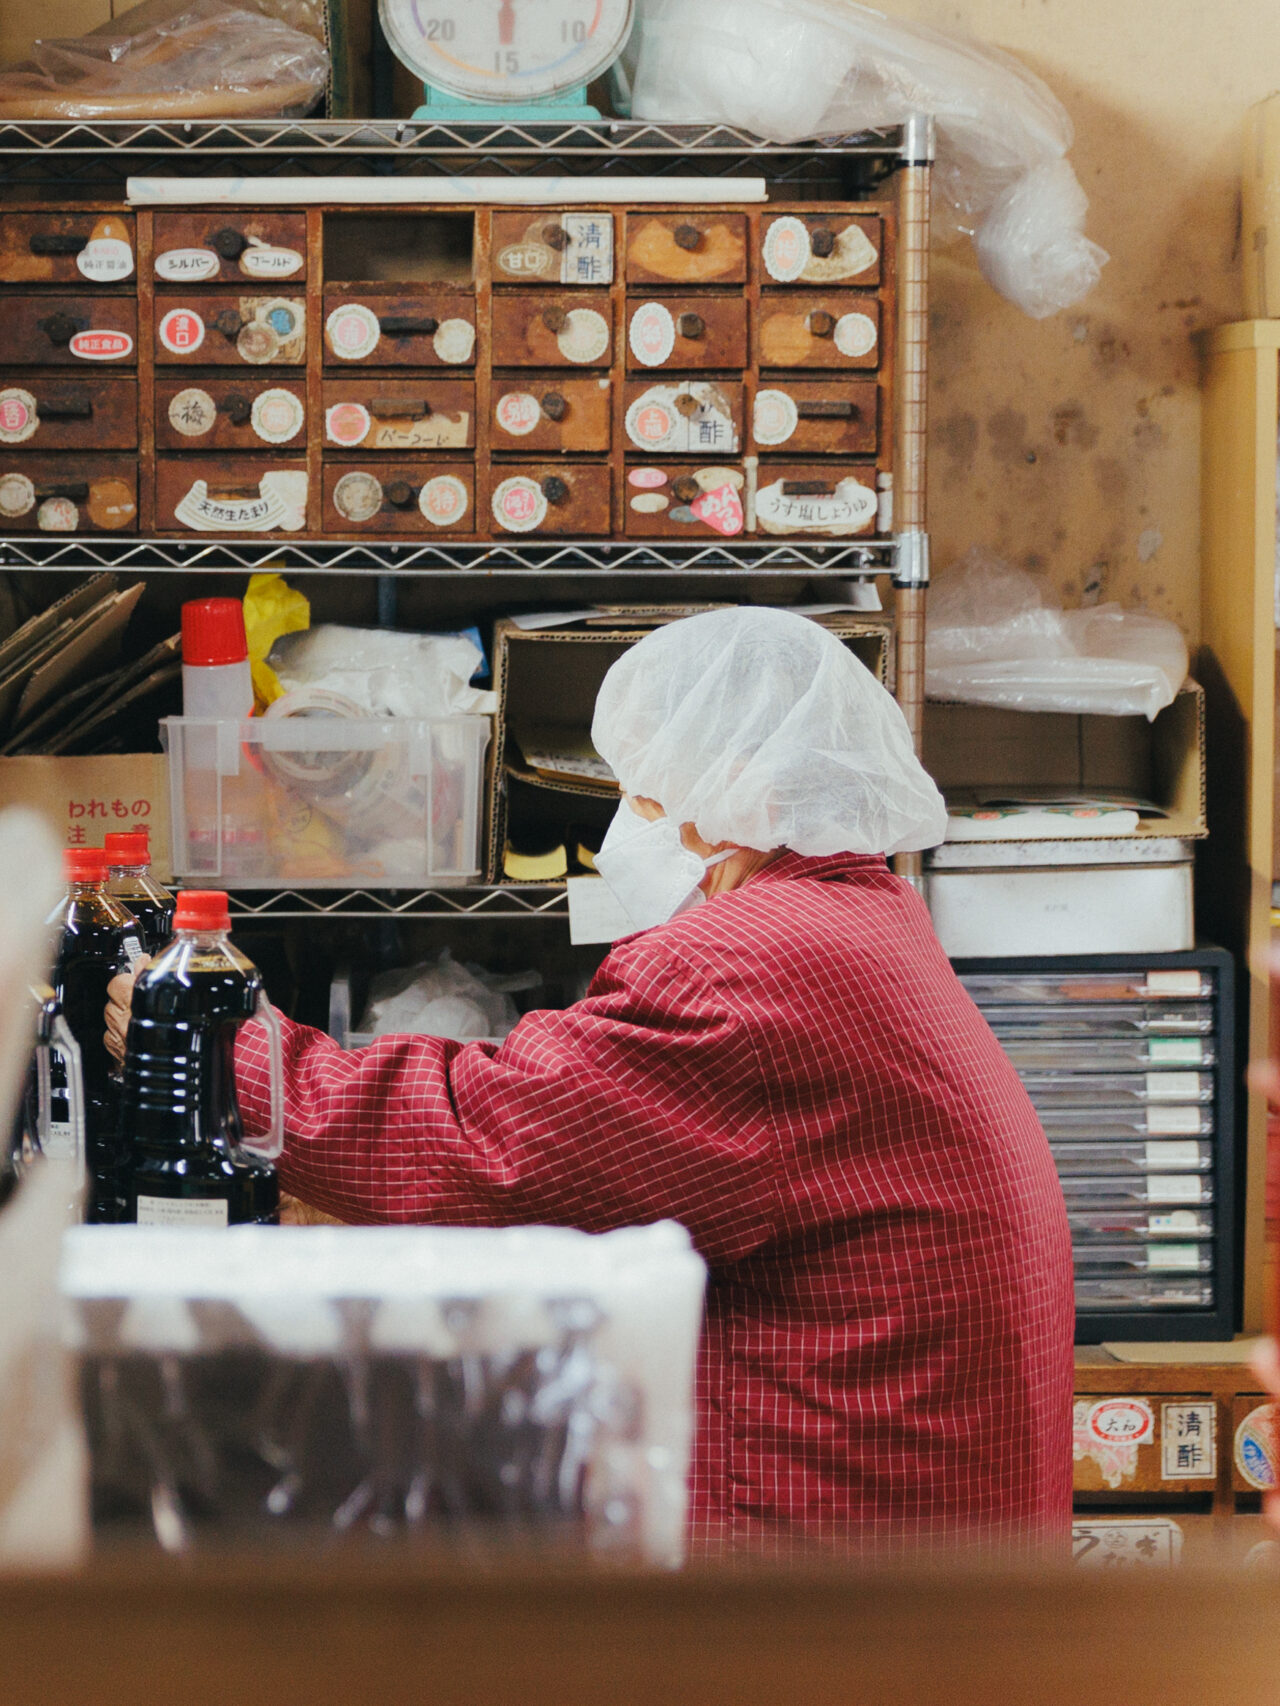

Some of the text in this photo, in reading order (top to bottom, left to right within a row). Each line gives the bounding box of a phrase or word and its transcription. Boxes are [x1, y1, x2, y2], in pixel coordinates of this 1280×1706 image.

[427, 19, 455, 42] 20
[561, 20, 586, 43] 10
[494, 51, 520, 74] 15
[250, 255, 293, 268] ゴールド
[506, 251, 541, 268] 甘口
[577, 221, 603, 281] 清酢
[168, 257, 210, 270] シルバー
[198, 501, 270, 522] 天然生たまり
[770, 498, 868, 521] うす塩しょうゆ
[68, 798, 152, 819] われもの
[67, 824, 87, 844] 注
[1177, 1410, 1203, 1469] 清酢
